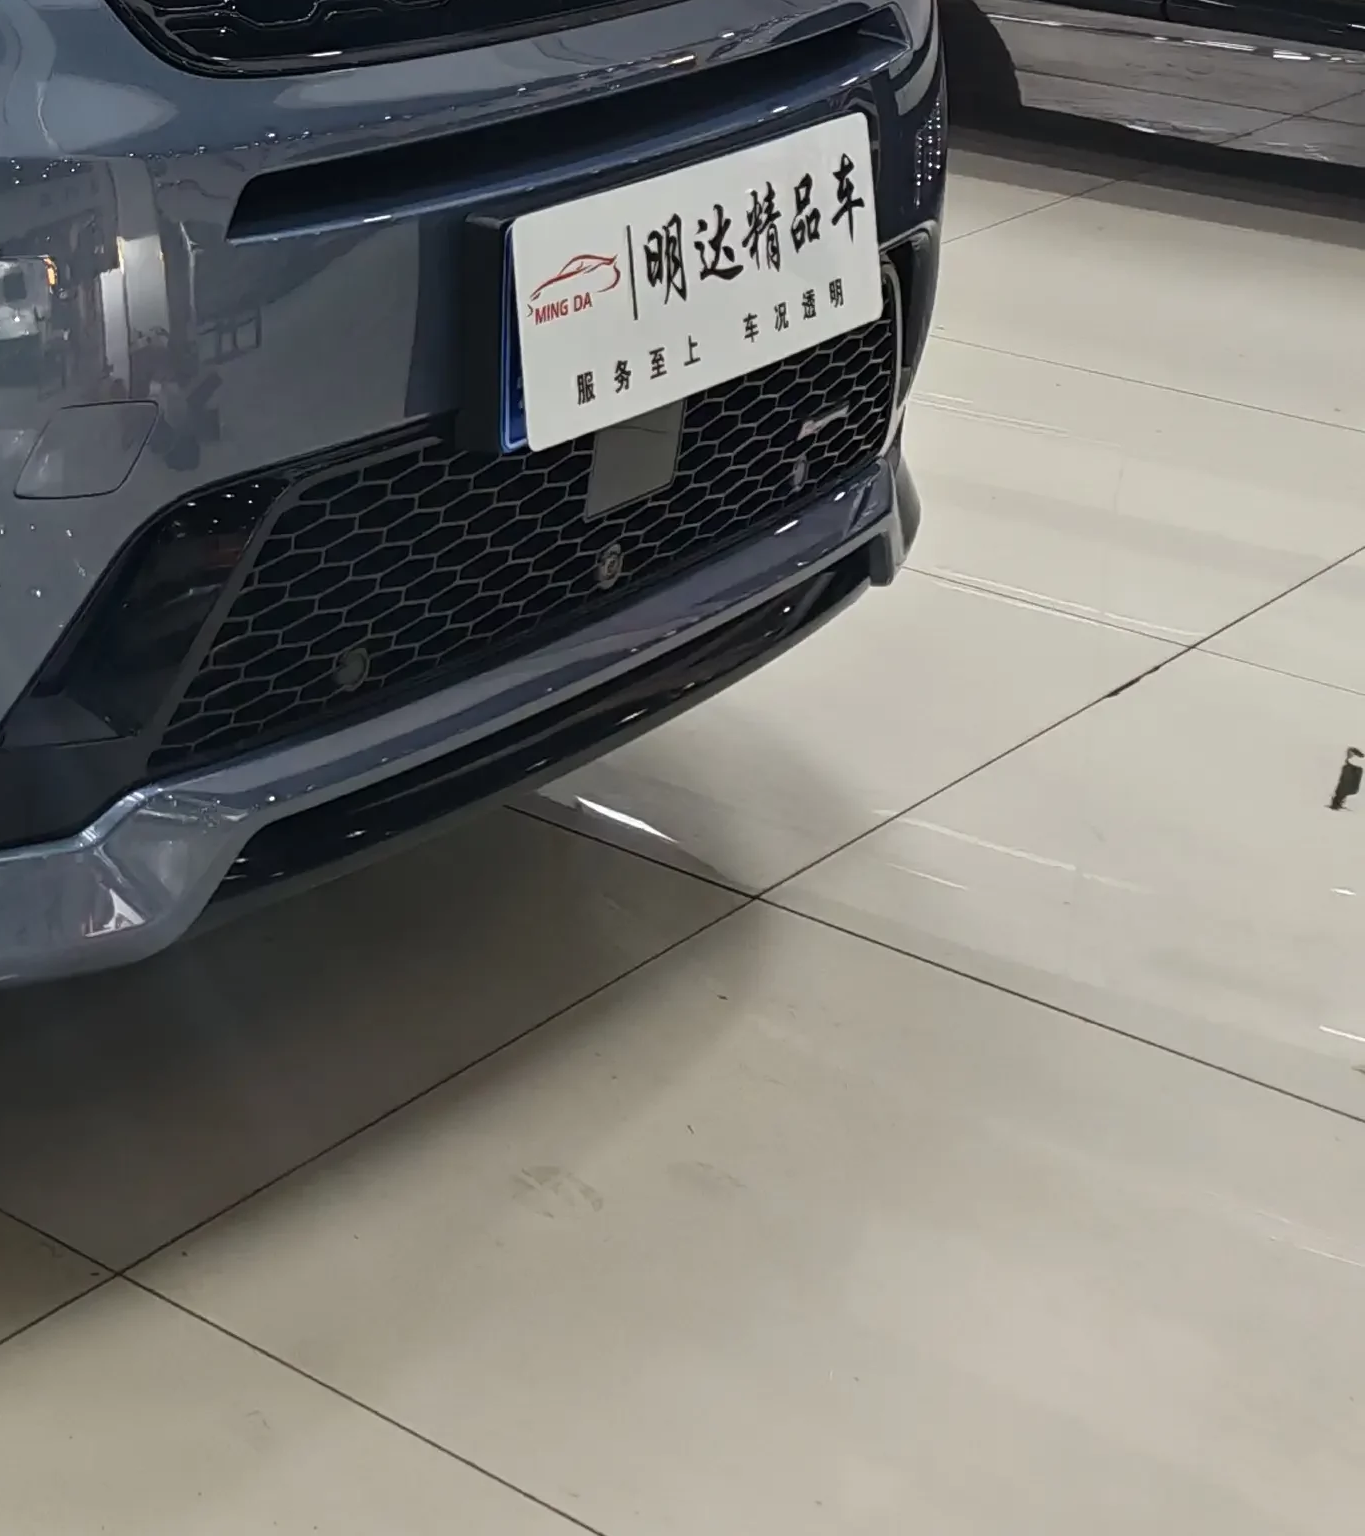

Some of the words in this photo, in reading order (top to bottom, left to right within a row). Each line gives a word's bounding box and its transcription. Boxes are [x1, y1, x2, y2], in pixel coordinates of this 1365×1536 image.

[644, 153, 864, 305] 明达精品车
[534, 298, 569, 325] MING
[573, 292, 593, 312] DA
[576, 336, 701, 405] 服务至上
